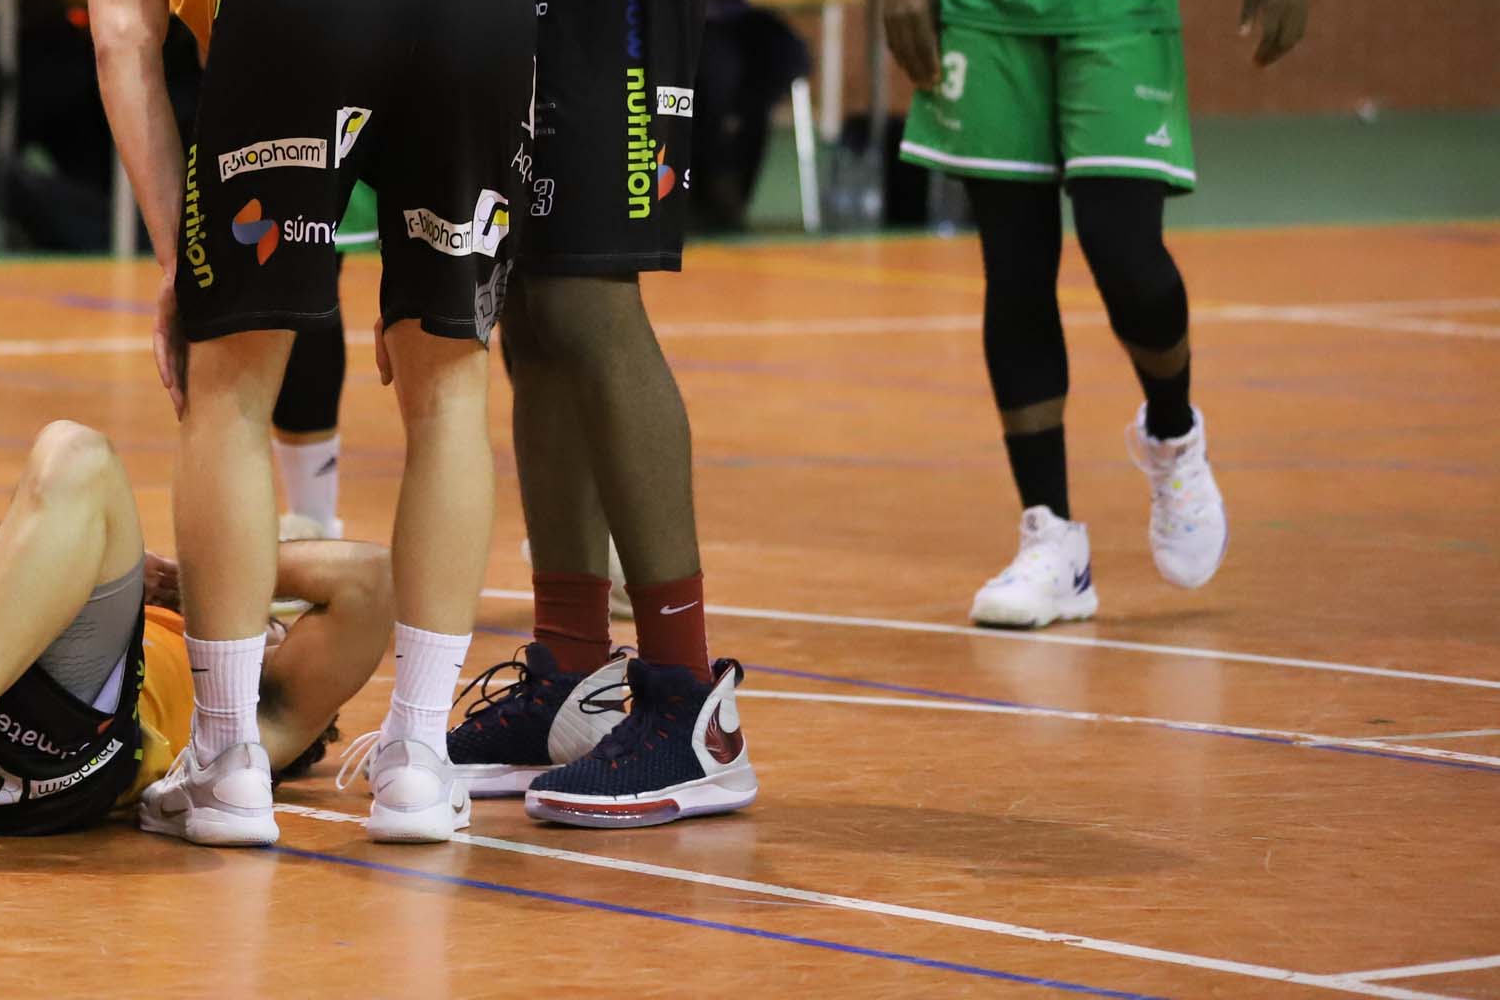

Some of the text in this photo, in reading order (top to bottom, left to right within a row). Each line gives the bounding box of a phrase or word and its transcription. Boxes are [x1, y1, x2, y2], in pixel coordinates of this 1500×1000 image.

[941, 51, 967, 101] 3
[627, 67, 657, 219] nutrition
[283, 214, 336, 244] súm
